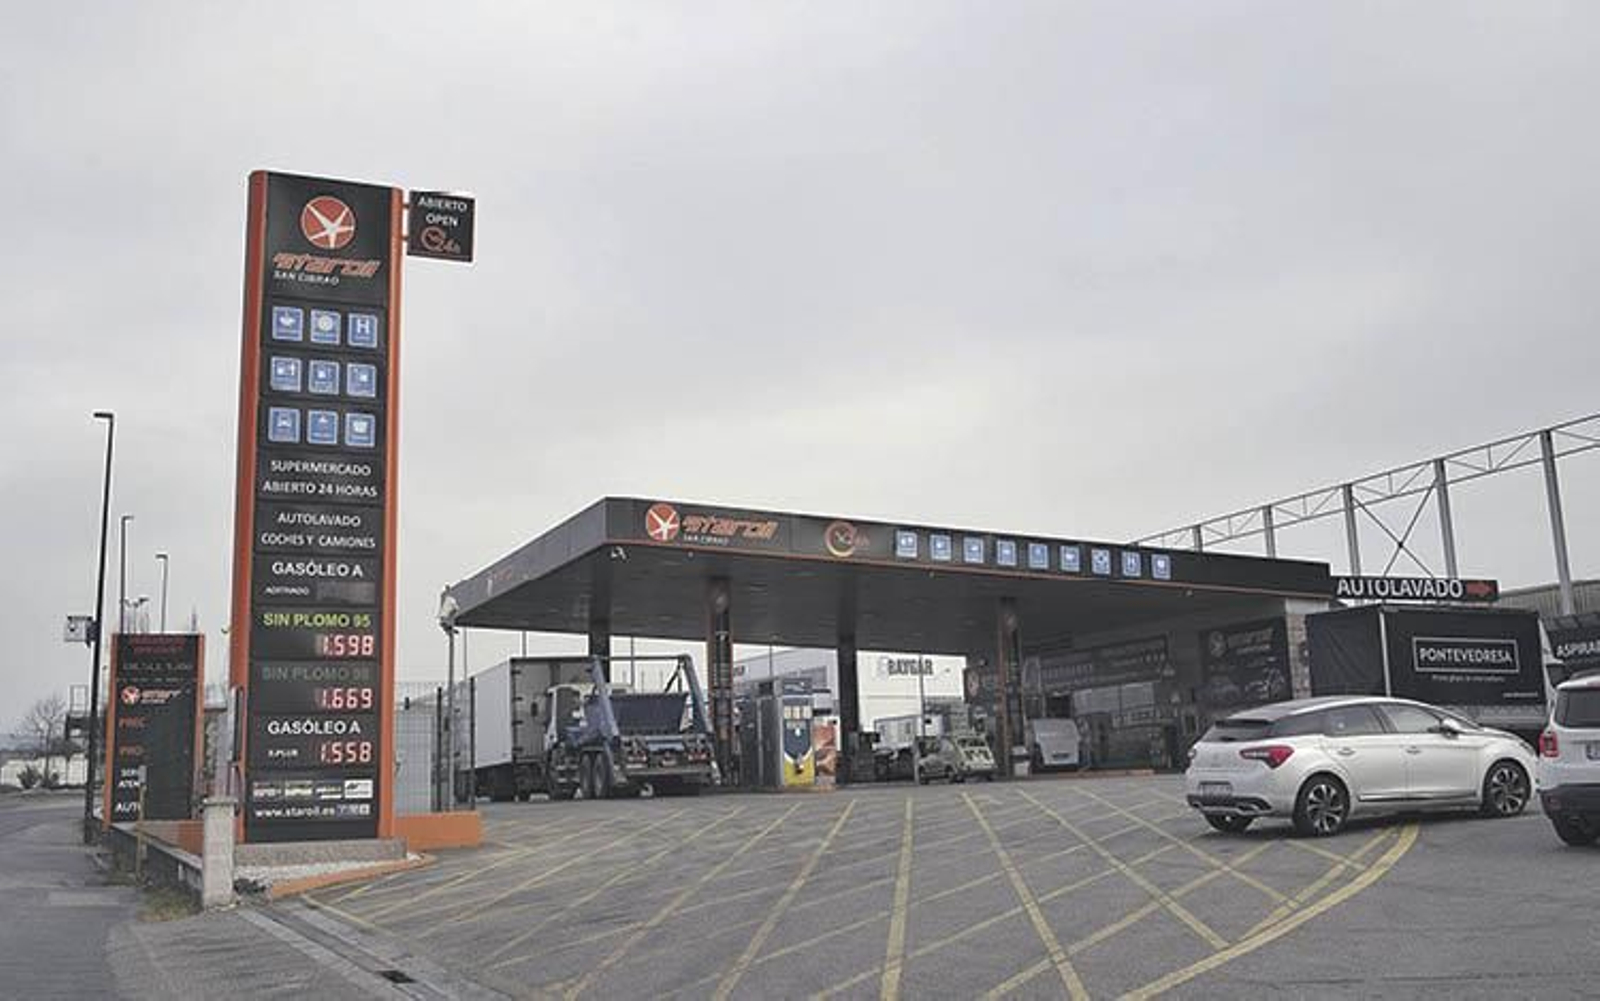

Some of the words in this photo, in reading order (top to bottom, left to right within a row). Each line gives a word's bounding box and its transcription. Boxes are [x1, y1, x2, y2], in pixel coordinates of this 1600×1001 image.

[417, 196, 468, 212] ABIERTO
[425, 212, 459, 227] OPEN
[271, 460, 371, 476] SUPERMERCADO
[262, 481, 316, 493] ABIERTO
[318, 483, 333, 495] 24
[336, 484, 378, 497] HORAS
[278, 513, 361, 527] AUTOLAVADO
[261, 532, 305, 546] COCHES
[307, 535, 315, 546] Y
[318, 535, 376, 549] CAMIONES
[272, 559, 349, 577] GASÓLEO
[352, 564, 363, 577] A
[1336, 579, 1463, 598] AUTOLAVADO
[263, 613, 290, 626] SIN
[294, 613, 350, 627] PLOMO
[353, 614, 371, 627] 95
[1419, 647, 1513, 663] PONTEVEDRESA
[262, 667, 289, 681] SIN
[293, 667, 348, 682] PLOMO
[267, 718, 347, 735] GASÓLEO
[349, 721, 361, 735] A
